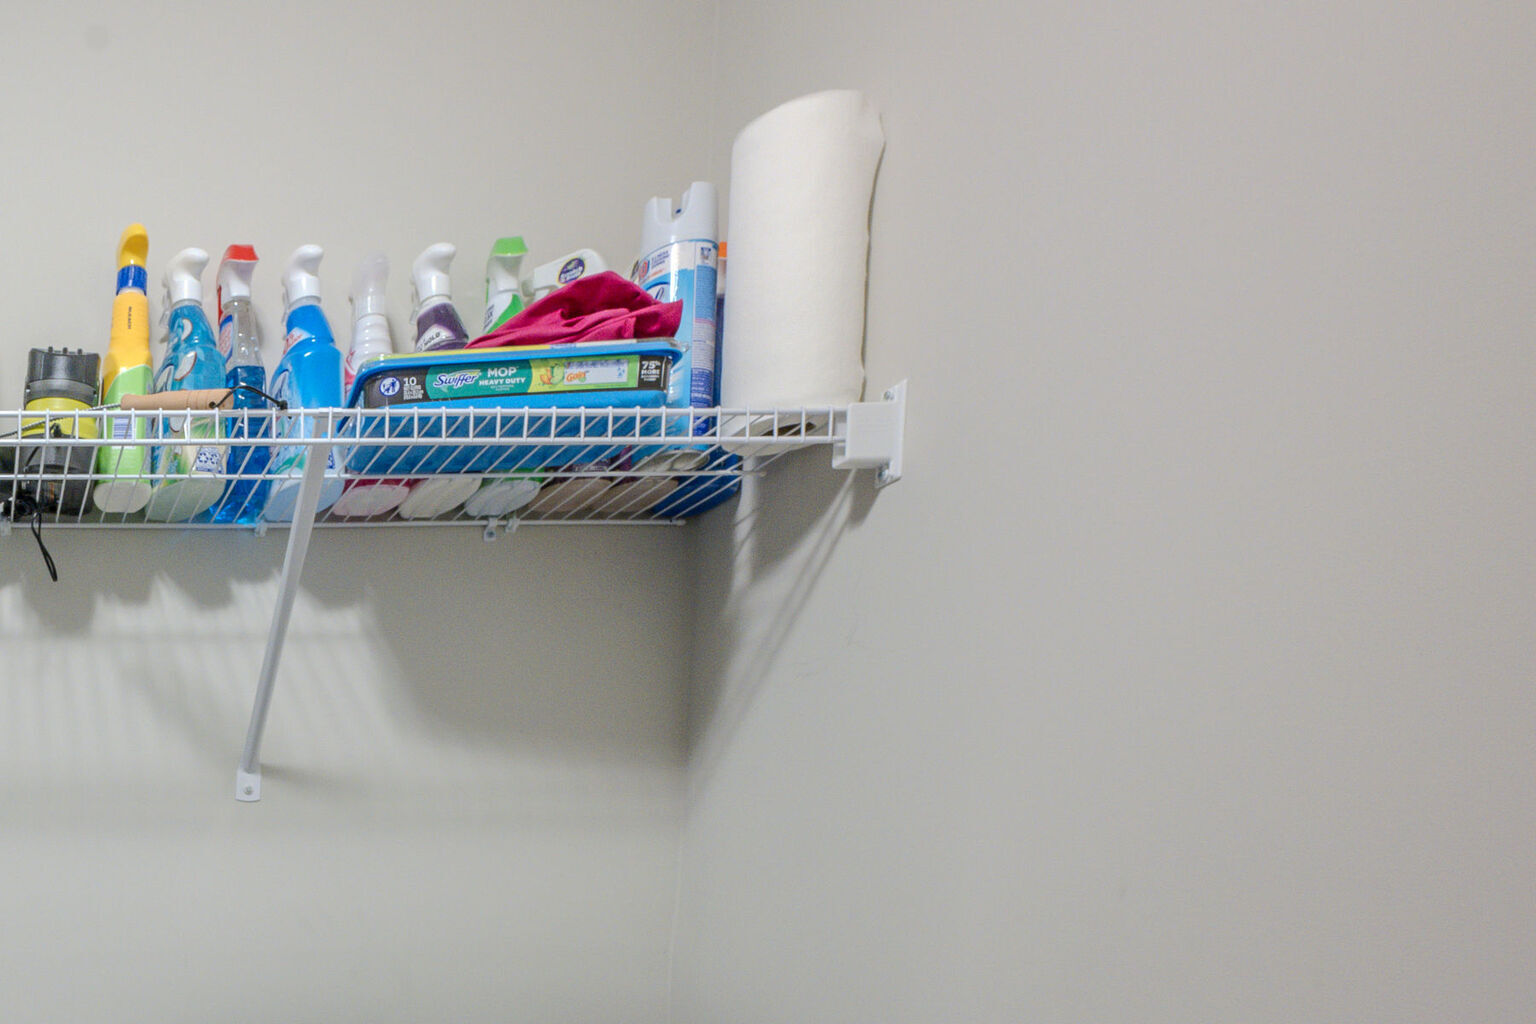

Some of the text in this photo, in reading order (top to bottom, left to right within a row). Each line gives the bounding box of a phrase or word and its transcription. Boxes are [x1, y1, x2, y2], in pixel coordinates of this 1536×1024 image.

[487, 367, 517, 378] MOP
[403, 377, 417, 386] 10
[433, 371, 480, 389] Swiffer
[479, 376, 526, 386] HEAVY DUTY
